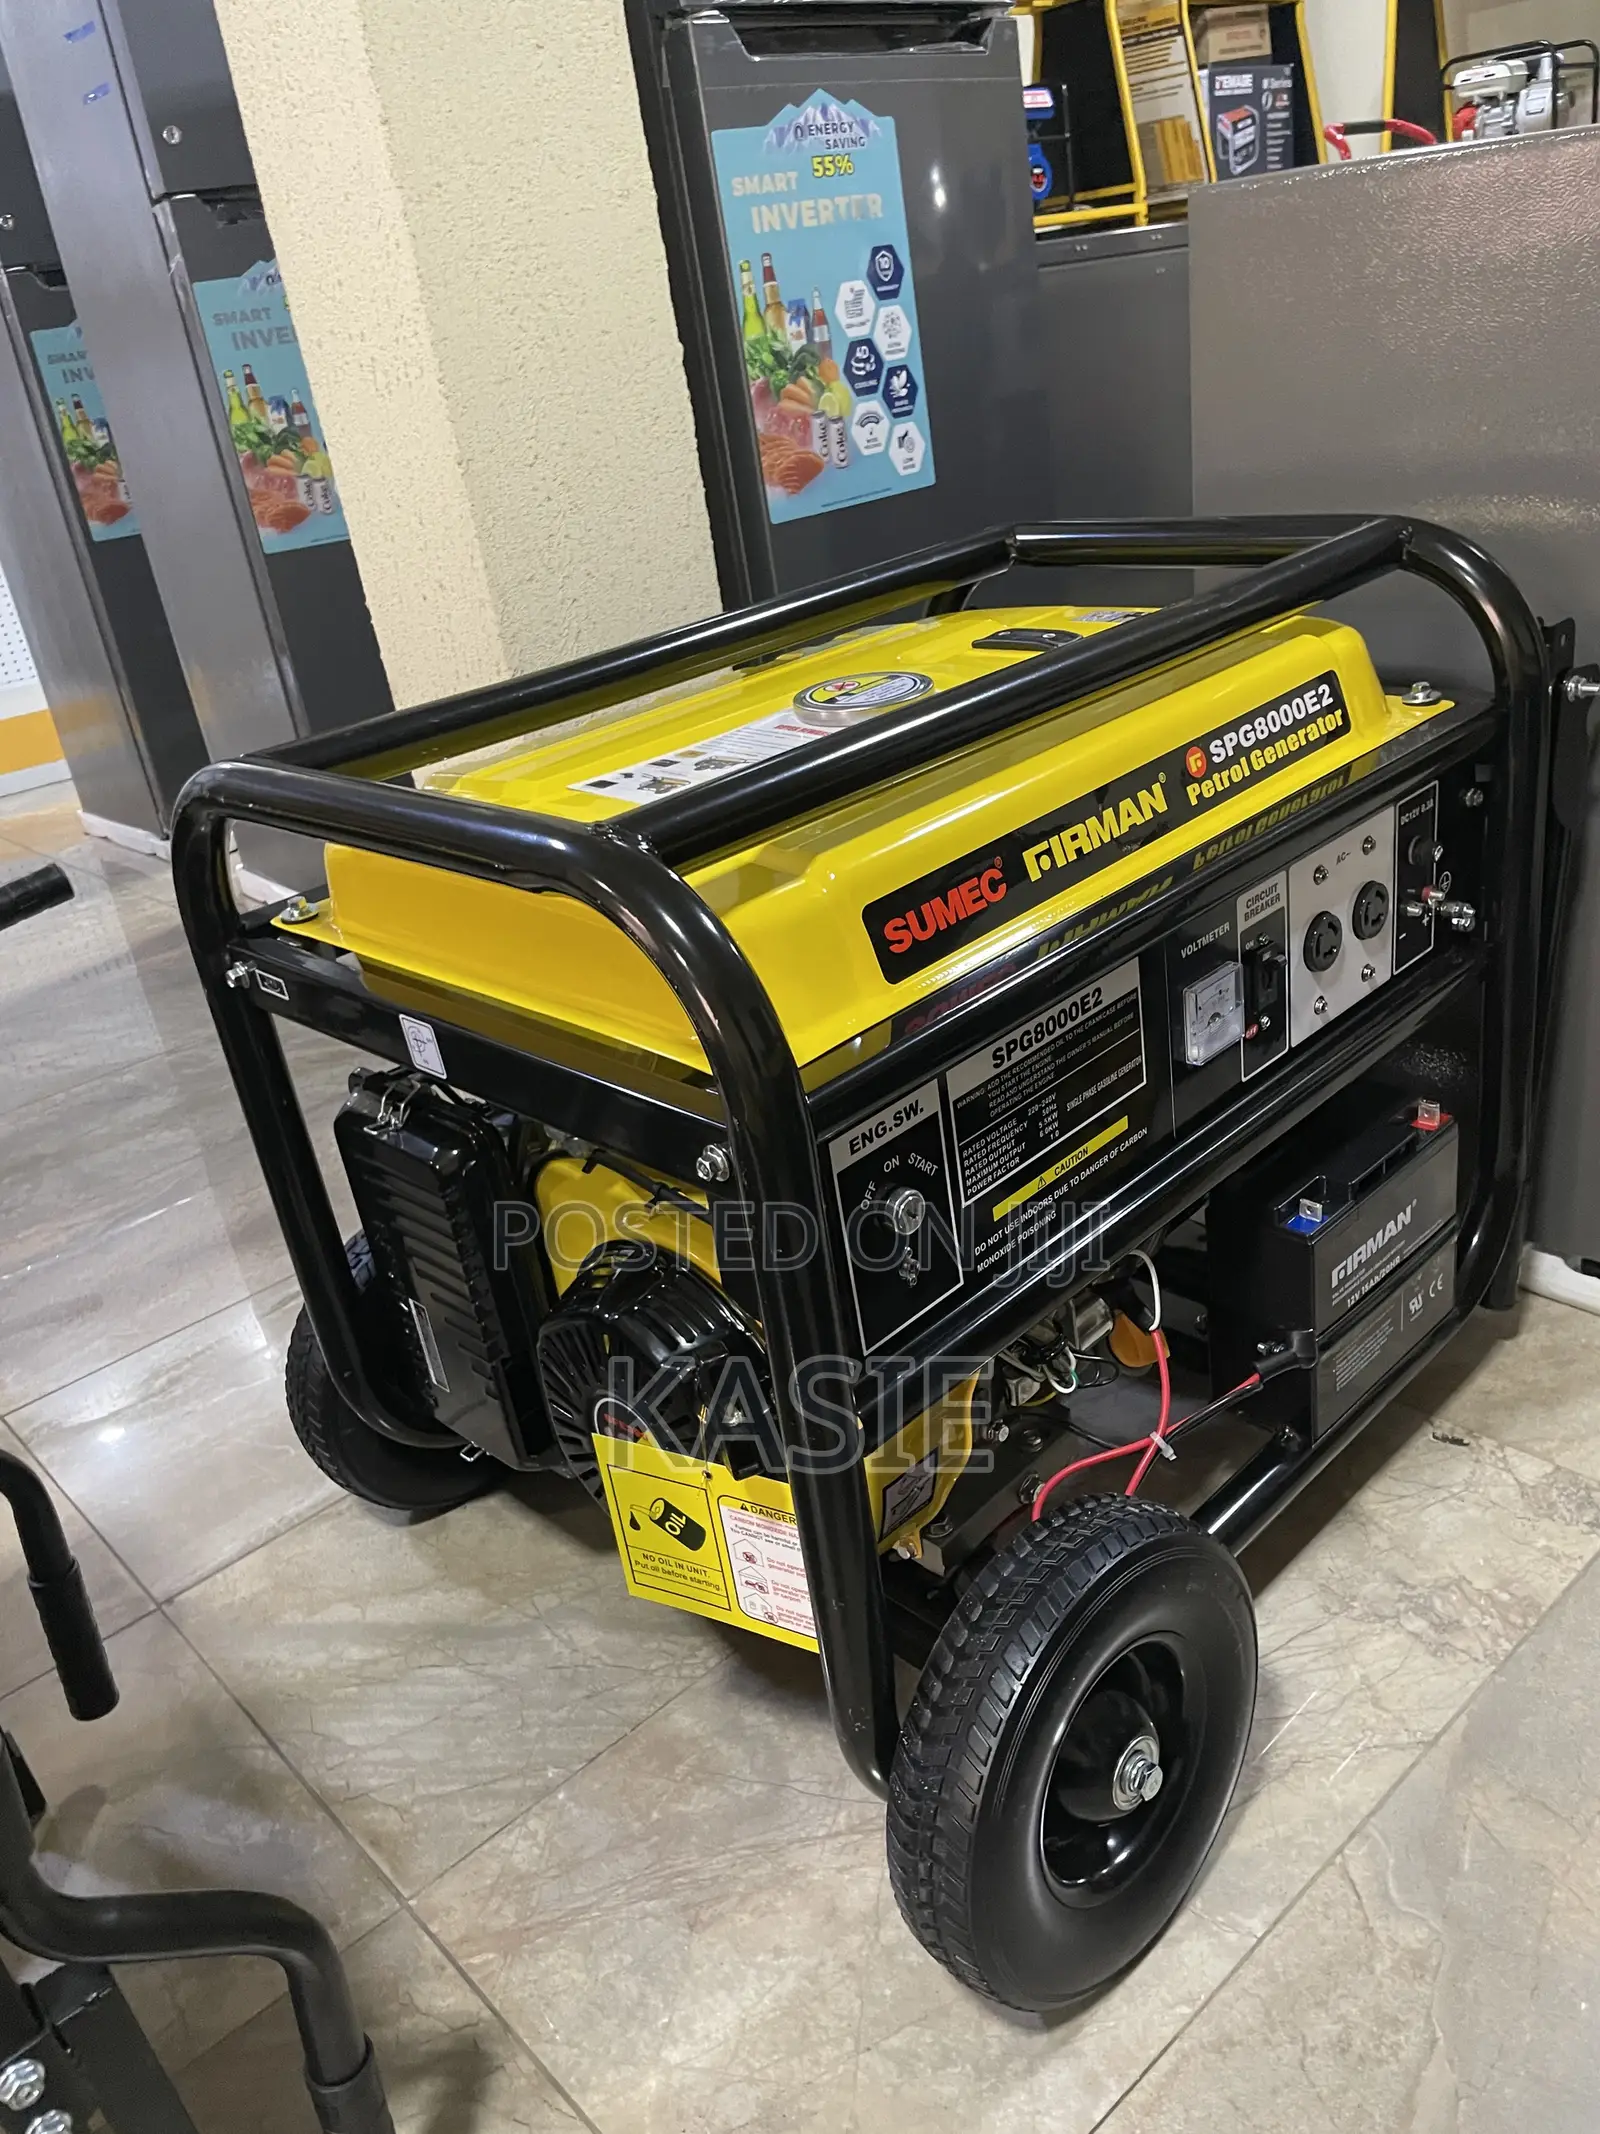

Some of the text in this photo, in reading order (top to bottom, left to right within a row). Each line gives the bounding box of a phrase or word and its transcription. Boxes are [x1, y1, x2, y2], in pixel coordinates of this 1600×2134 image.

[807, 122, 855, 137] ENERGY
[825, 136, 866, 150] SAVING
[811, 153, 856, 178] 55%
[731, 171, 799, 197] SMART
[751, 193, 883, 234] INVERTER
[213, 306, 271, 327] SMART
[1209, 683, 1334, 764] SPG8000E2
[1186, 708, 1344, 807] Petrol Generator
[884, 782, 1168, 954] SUMEC FIRMAN
[1244, 892, 1281, 922] BREAKER
[1246, 882, 1278, 910] CIRCUIT
[1181, 921, 1230, 959] VOLTMETER
[992, 987, 1103, 1069] SPG8000E2
[988, 1095, 1006, 1109] READ
[1005, 1086, 1018, 1098] AND
[1018, 1063, 1056, 1091] UNDERSTAND
[1055, 1055, 1067, 1067] THE
[1091, 1026, 1114, 1043] MANUAL
[1000, 1070, 1013, 1083] THE
[1012, 1043, 1056, 1075] RECOMMENDED
[1001, 1076, 1020, 1092] START
[1020, 1069, 1032, 1082] THE
[1066, 1093, 1083, 1112] SINGLE
[1082, 1083, 1097, 1101] PHASE
[1117, 1054, 1142, 1078] GENERATOR
[989, 1092, 1023, 1118] OPERATING
[1023, 1085, 1034, 1096] THE
[849, 1098, 924, 1157] ENG.SW.
[962, 1092, 1057, 1159] RATED VOLTAGE 220-240V
[963, 1148, 987, 1168] RATED
[987, 1120, 1029, 1153] FREQUENCY
[964, 1157, 988, 1178] RATED
[988, 1138, 1016, 1162] OUTPUT
[1054, 1146, 1089, 1177] CAUTION
[883, 1155, 900, 1173] ON
[908, 1152, 938, 1177] START
[965, 1161, 999, 1187] MAXIMUM
[999, 1141, 1026, 1165] OUTPUT
[967, 1175, 993, 1197] POWER
[993, 1156, 1021, 1178] FACTOR
[860, 1180, 876, 1211] OFF
[974, 1126, 1148, 1256] DO NOT USE INDOORS DUE TO DANGER OF CARBON
[976, 1210, 1057, 1274] MONOXIDE POISONING
[1331, 1203, 1412, 1289] FIRMAN
[664, 1511, 687, 1537] OIL
[751, 1505, 796, 1526] DANGER
[755, 1521, 788, 1537] MONOXIDE
[634, 1560, 649, 1570] Put
[650, 1564, 660, 1572] oil
[661, 1566, 688, 1580] before
[642, 1552, 656, 1563] NO
[657, 1557, 673, 1568] OIL
[674, 1561, 685, 1571] IN
